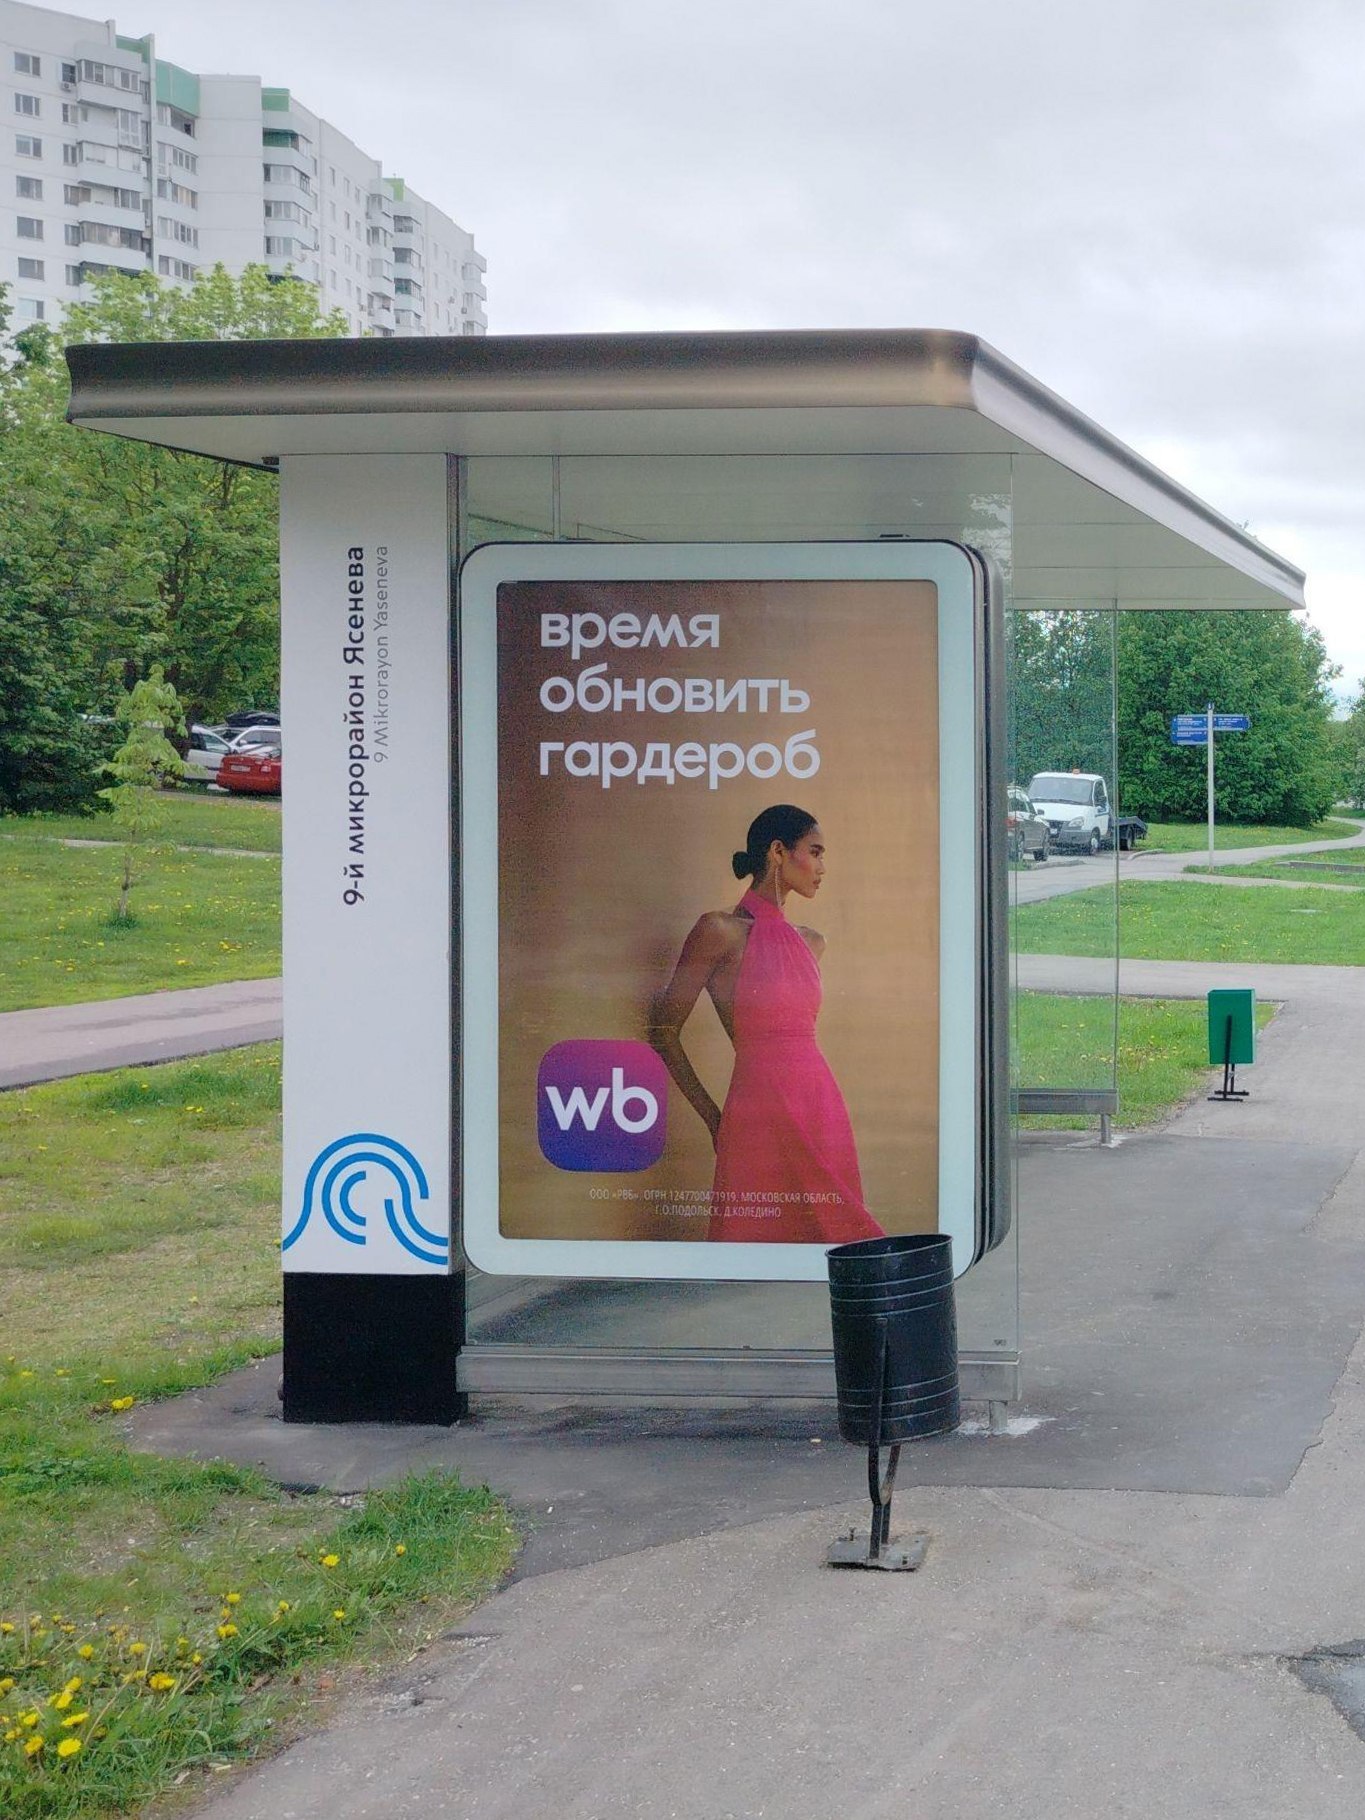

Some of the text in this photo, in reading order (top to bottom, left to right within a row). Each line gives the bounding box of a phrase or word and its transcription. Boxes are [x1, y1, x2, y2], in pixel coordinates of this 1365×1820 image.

[373, 546, 392, 763] 9 Mikrorayon Yaseneva
[540, 612, 720, 659] время
[539, 664, 810, 714] обновить
[343, 547, 370, 906] 9-й микрорайон Ясенева
[540, 730, 820, 789] гардероб
[545, 1067, 658, 1133] wb
[589, 1188, 610, 1200] ООО
[643, 1189, 667, 1201] ОГРН
[740, 1191, 801, 1203] МОСКОВСКАЯ
[803, 1192, 845, 1205] ОБЛАСТЬ,
